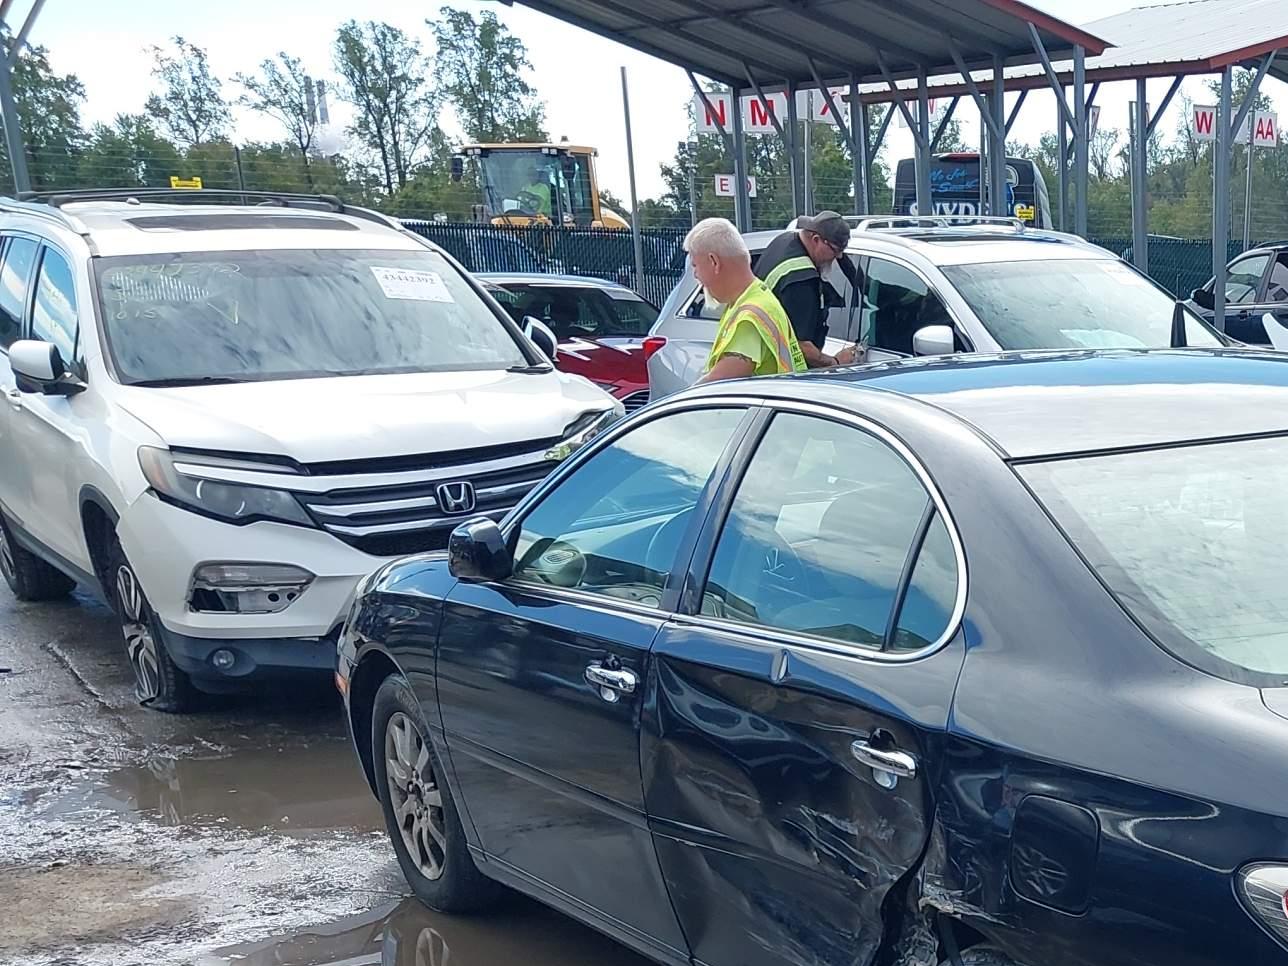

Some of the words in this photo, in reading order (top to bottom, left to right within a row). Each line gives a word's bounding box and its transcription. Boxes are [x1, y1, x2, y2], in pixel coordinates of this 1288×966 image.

[705, 99, 726, 126] N
[750, 99, 775, 126] M
[1195, 111, 1214, 134] W
[1255, 117, 1275, 140] AA
[719, 177, 730, 193] E
